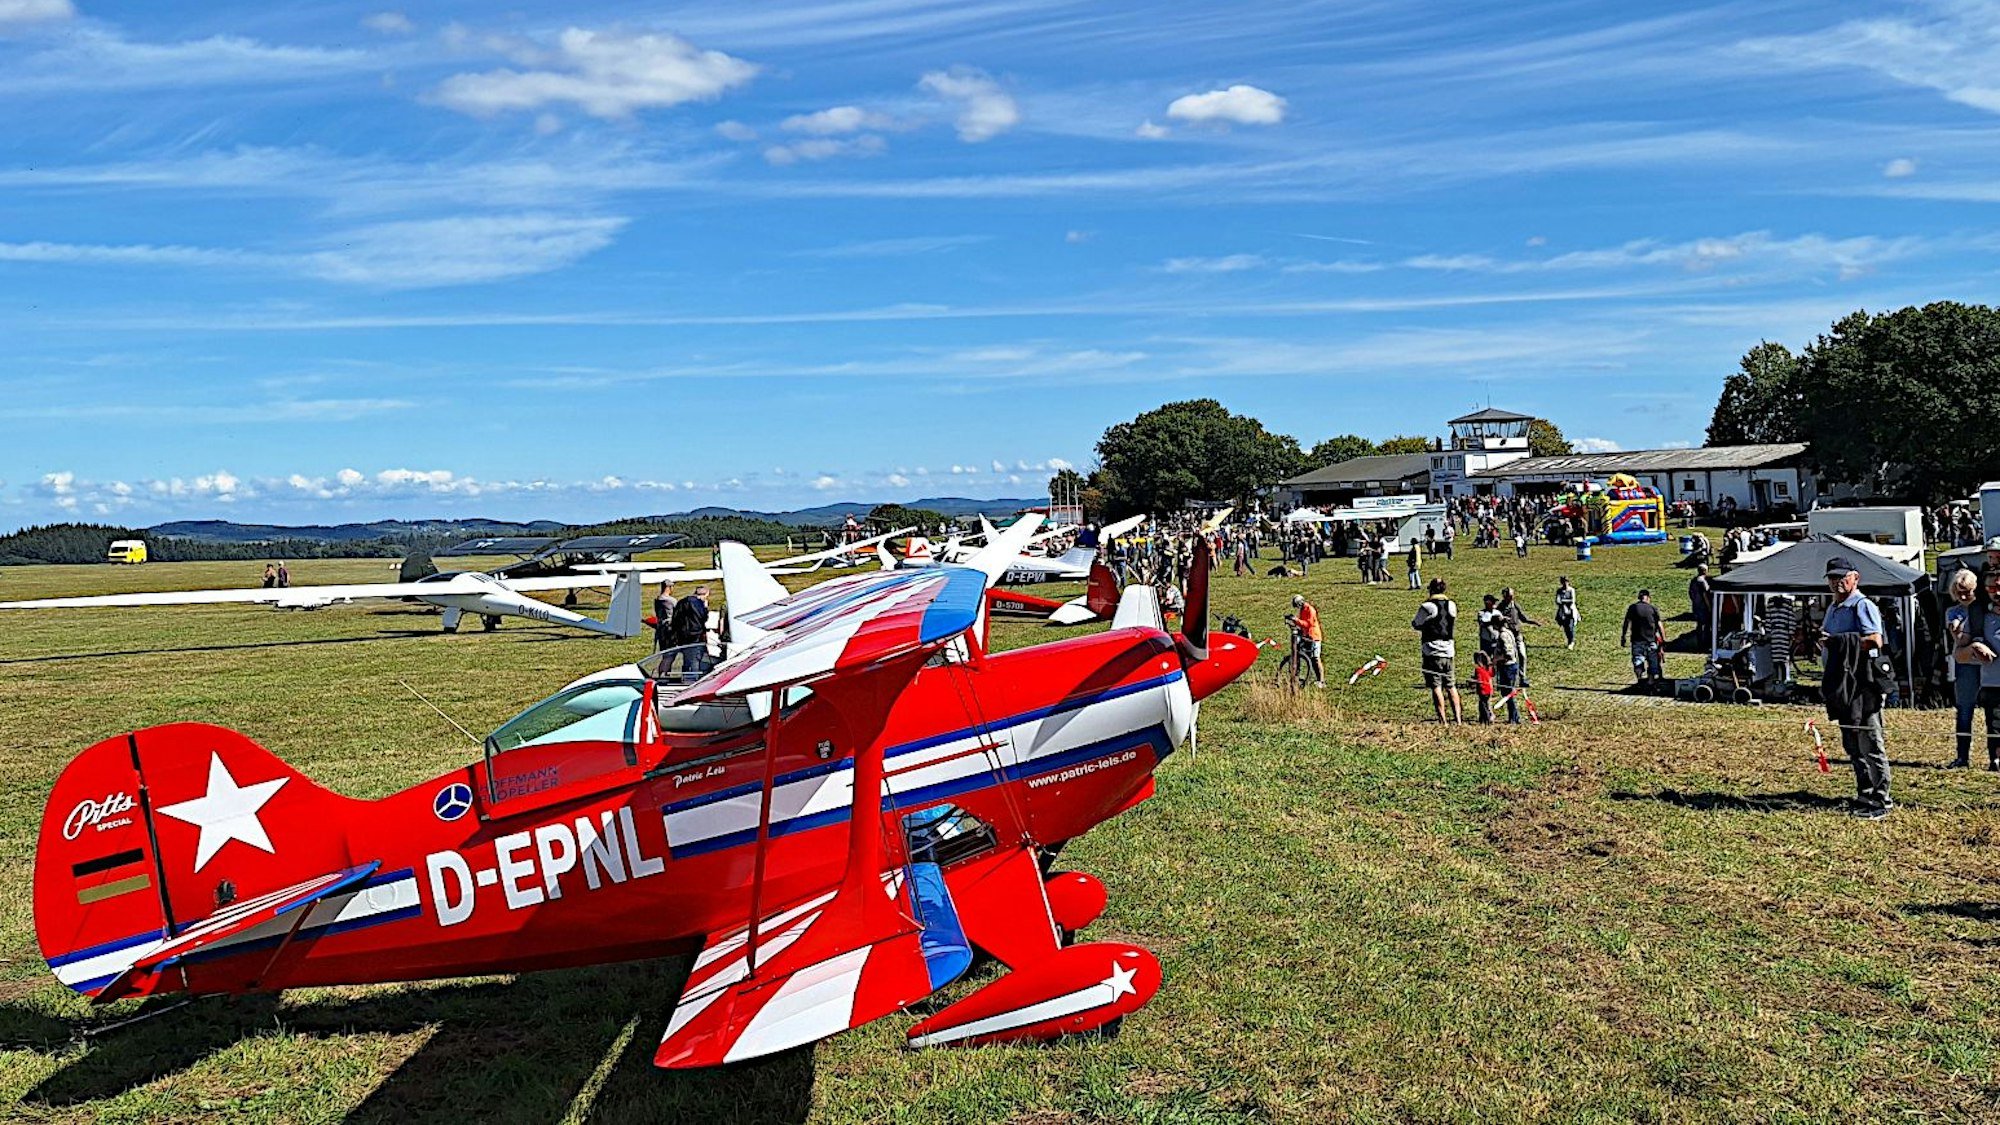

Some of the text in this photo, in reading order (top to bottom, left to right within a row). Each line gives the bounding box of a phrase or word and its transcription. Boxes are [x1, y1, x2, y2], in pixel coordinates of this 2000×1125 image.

[1006, 571, 1046, 582] D-EPVA
[1028, 751, 1137, 788] www.patric-leis.de
[63, 792, 138, 840] Pitts
[97, 817, 133, 832] SPECIAL
[425, 805, 665, 927] D-EPNL
